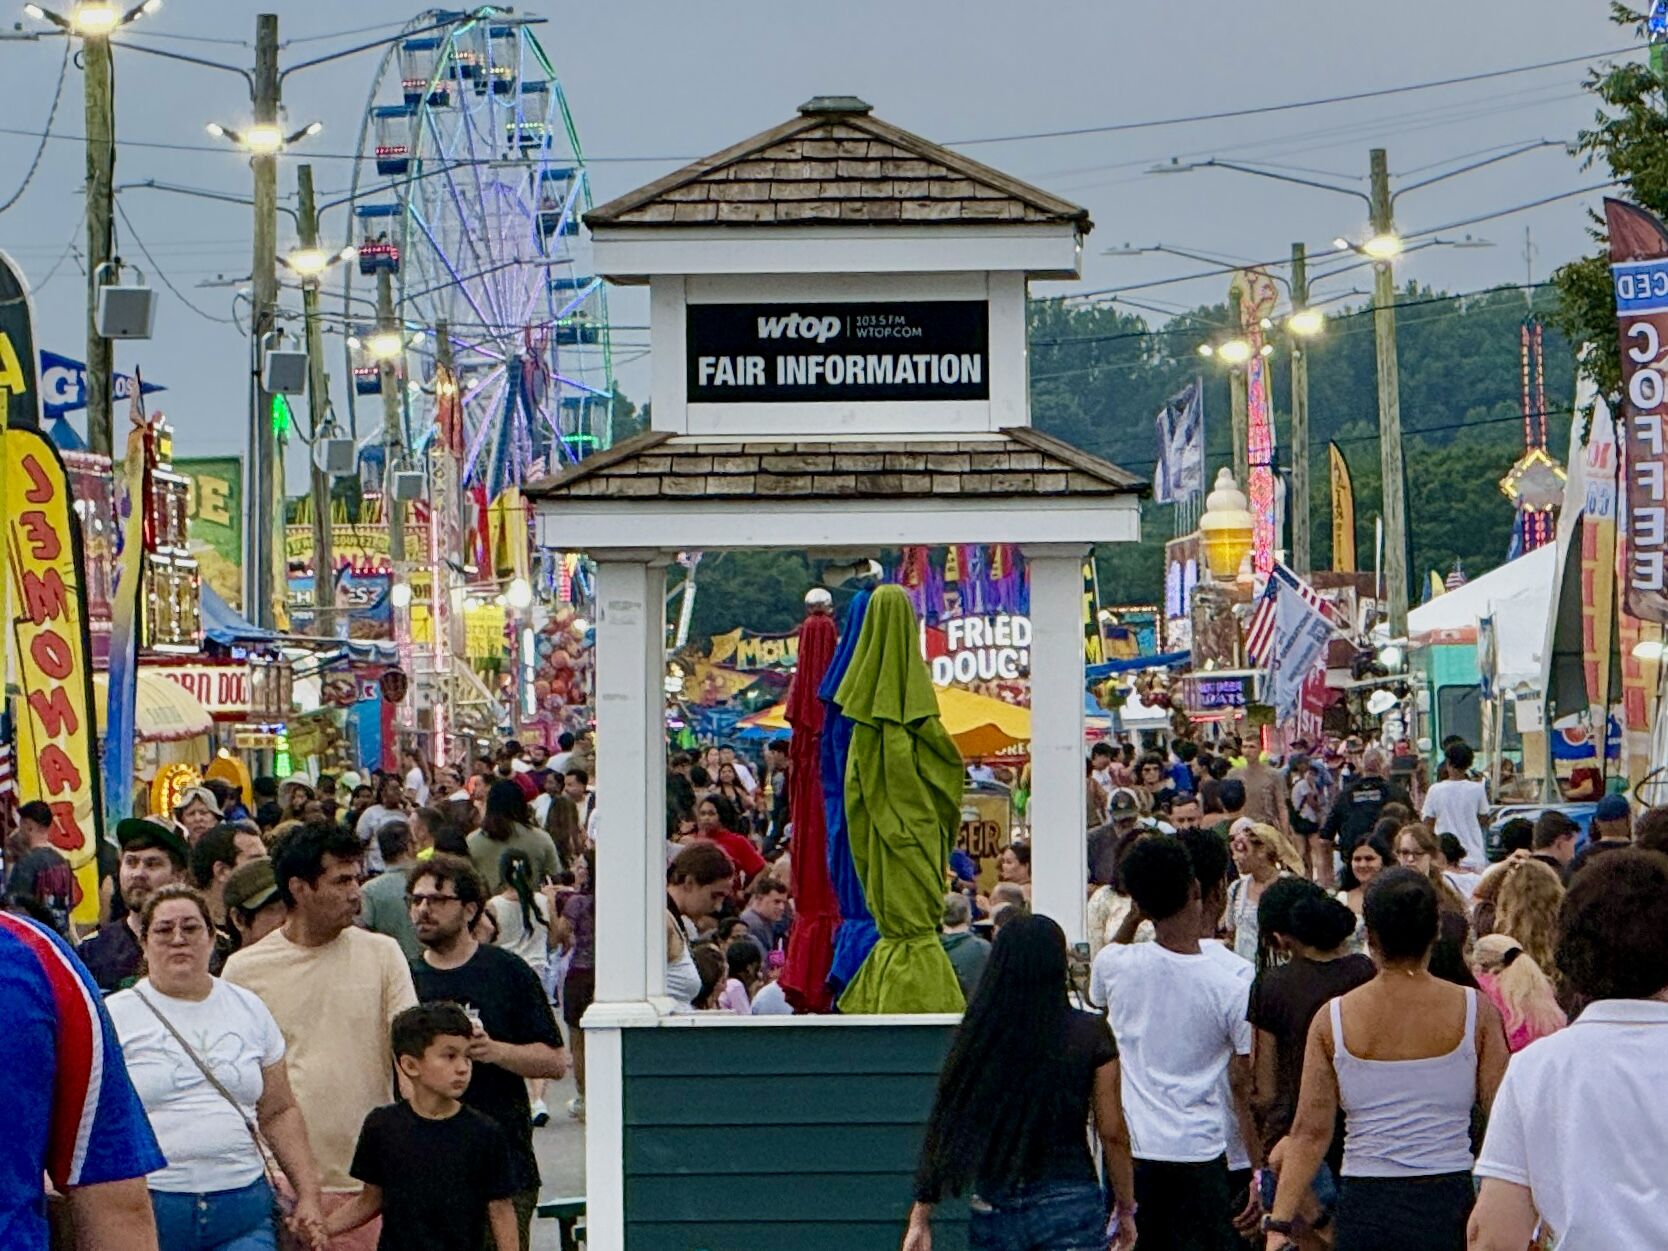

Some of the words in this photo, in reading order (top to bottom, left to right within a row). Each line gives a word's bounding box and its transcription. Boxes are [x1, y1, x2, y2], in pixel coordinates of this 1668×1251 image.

[757, 312, 842, 344] wtop
[856, 327, 923, 339] WTOP.COM
[888, 315, 906, 325] FM
[42, 366, 136, 405] GOS
[697, 355, 766, 386] FAIR
[776, 353, 982, 386] INFORMATION
[947, 615, 1032, 651] FRIED
